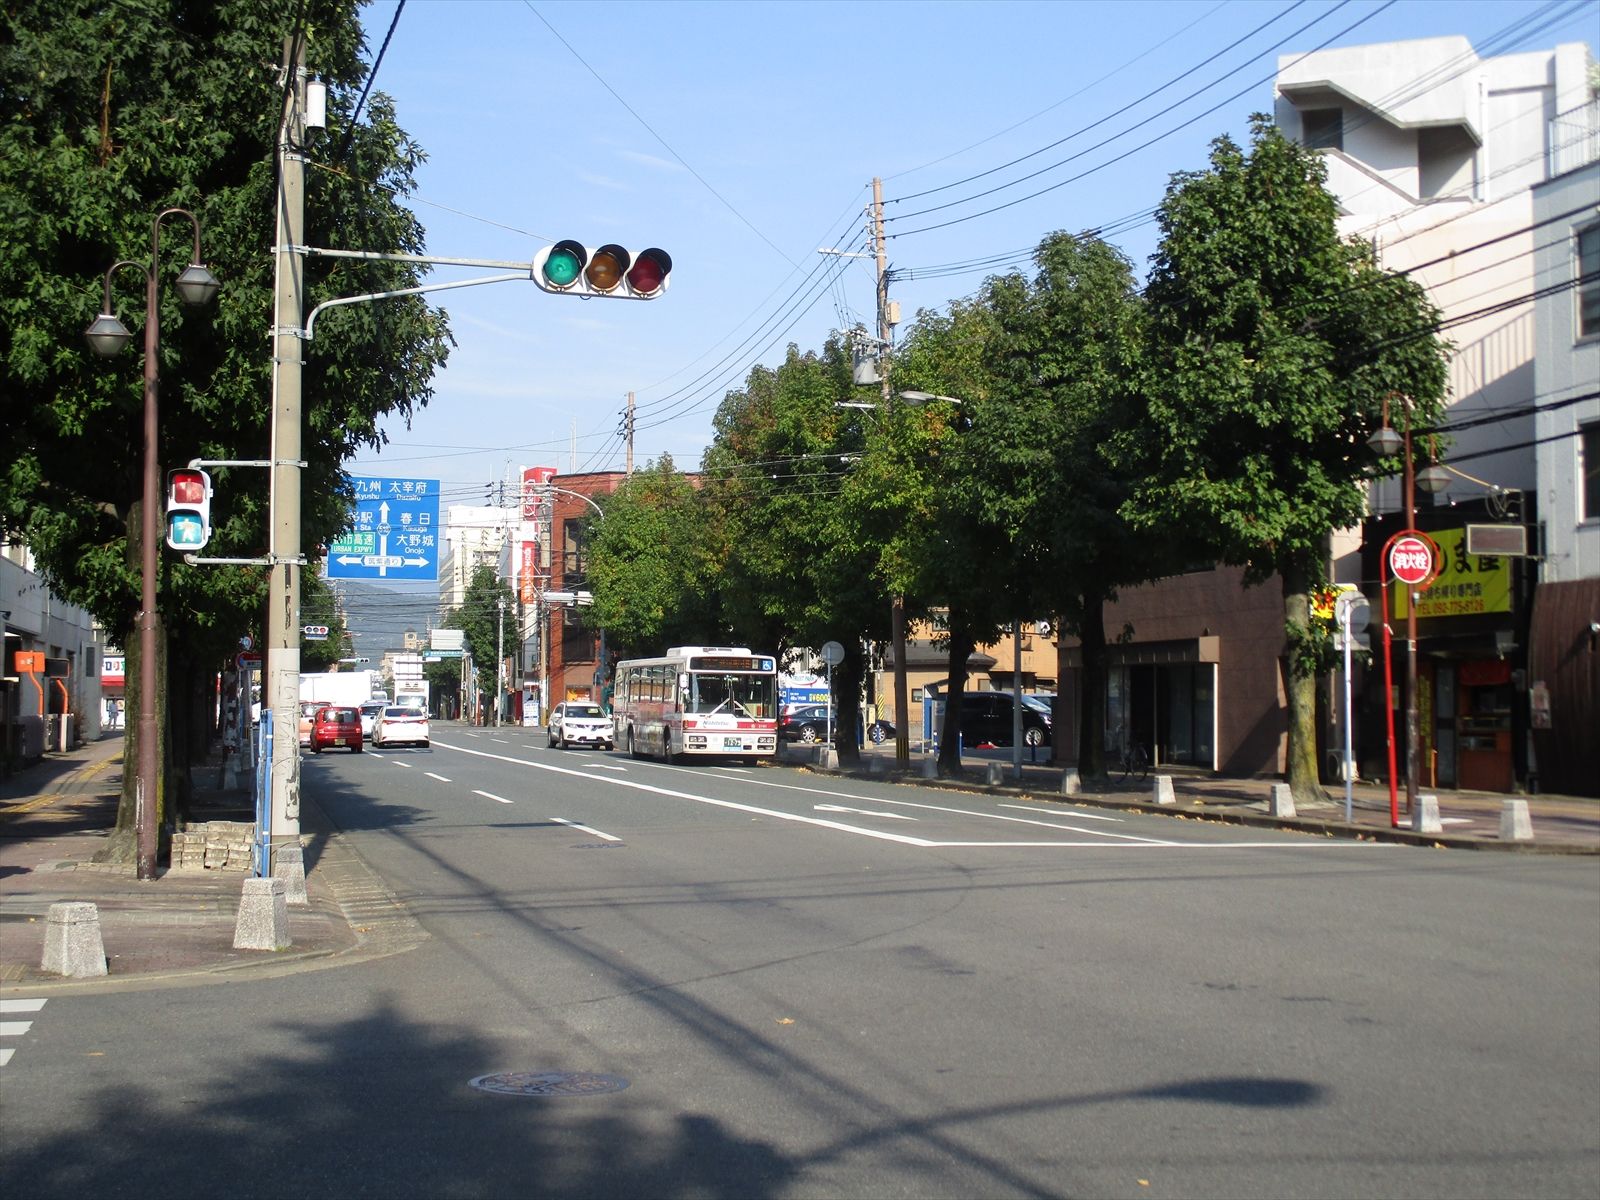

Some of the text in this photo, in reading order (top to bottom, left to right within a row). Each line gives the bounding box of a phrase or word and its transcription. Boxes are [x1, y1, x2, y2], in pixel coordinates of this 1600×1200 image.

[389, 481, 428, 494] 太宰府
[400, 512, 430, 525] 春日
[396, 534, 435, 547] 大野城
[333, 545, 374, 553] URBAN EXPWY
[1394, 552, 1428, 570] 消火栓
[1418, 602, 1431, 615] TEL
